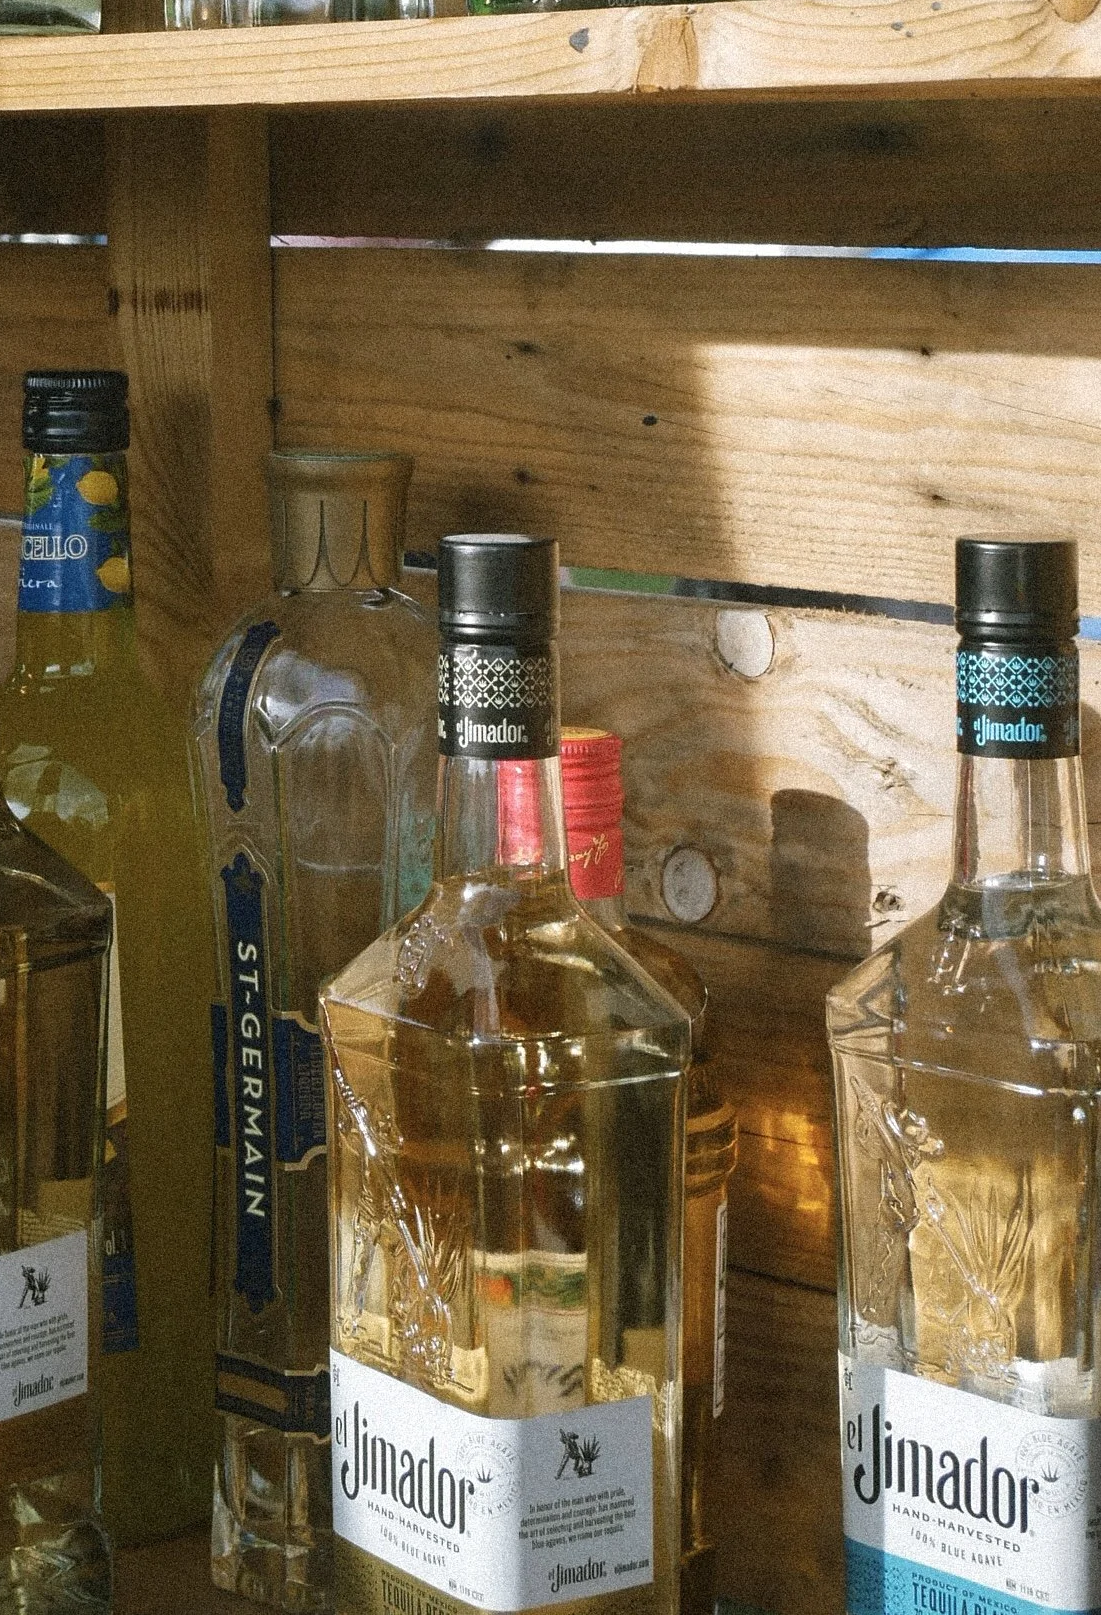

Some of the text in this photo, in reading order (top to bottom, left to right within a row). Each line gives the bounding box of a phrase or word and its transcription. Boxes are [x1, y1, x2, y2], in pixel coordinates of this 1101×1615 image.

[459, 716, 527, 748] Jimador
[976, 714, 1044, 746] Jimador
[335, 1400, 475, 1535] el Jimador
[846, 1402, 1040, 1534] el Jimador
[367, 1500, 461, 1553] HAND-HARVESTED
[379, 1525, 447, 1568] 100% BLUE AGAVE
[892, 1503, 1021, 1554] HAND-HARVESTED
[910, 1527, 1003, 1568] 100% BLUE AGAVE
[381, 1569, 414, 1591] PRODUCT
[428, 1594, 458, 1614] MEXICO
[551, 1556, 606, 1593] Jimador
[911, 1571, 1018, 1614] PRODUCT OF MEXICO
[911, 1581, 970, 1615] TEQUILA
